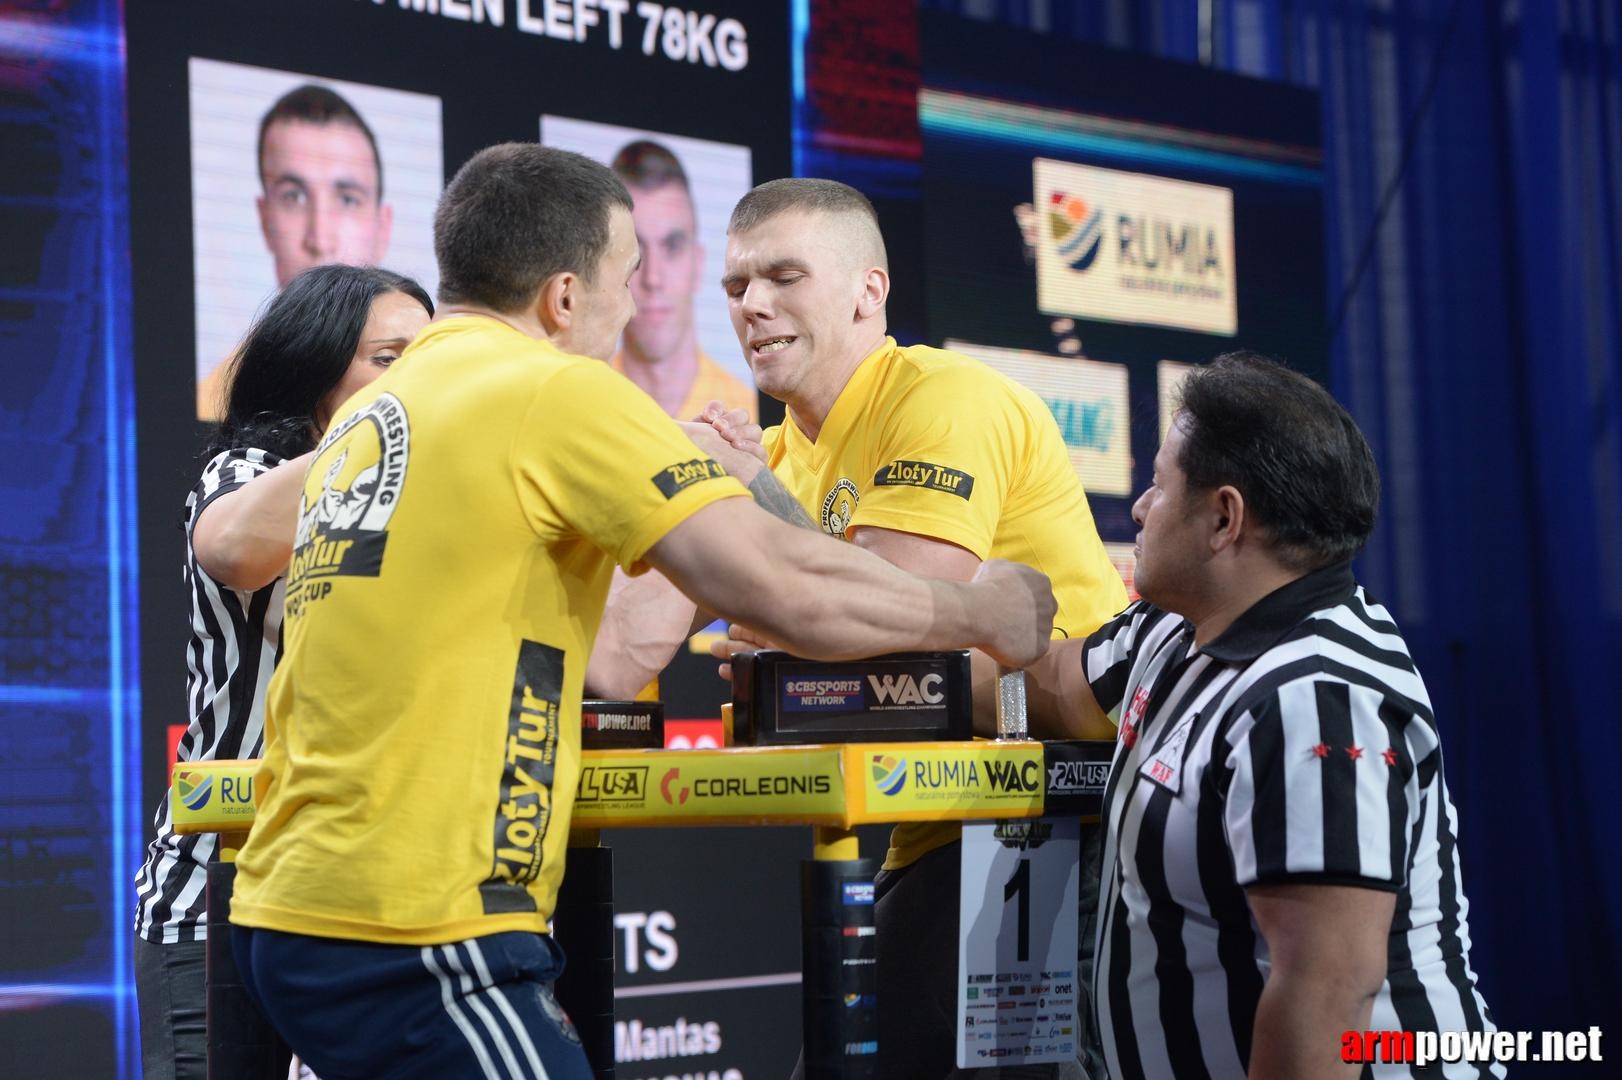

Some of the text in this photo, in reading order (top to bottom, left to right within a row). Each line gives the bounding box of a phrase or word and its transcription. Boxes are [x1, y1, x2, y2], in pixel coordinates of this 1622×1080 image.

[517, 0, 629, 49] LEFT
[636, 4, 749, 72] 78KG
[1118, 213, 1225, 276] RUMIA
[801, 695, 846, 706] NETWORK
[867, 673, 945, 705] WAC
[582, 713, 652, 731] rmpower.net
[221, 777, 252, 804] RU
[602, 772, 639, 795] USA
[694, 775, 831, 797] CORLEONIS
[915, 760, 1040, 792] RUMIA WAC
[1004, 859, 1030, 961] 1
[614, 910, 679, 974] TS
[613, 1016, 722, 1064] Mantas
